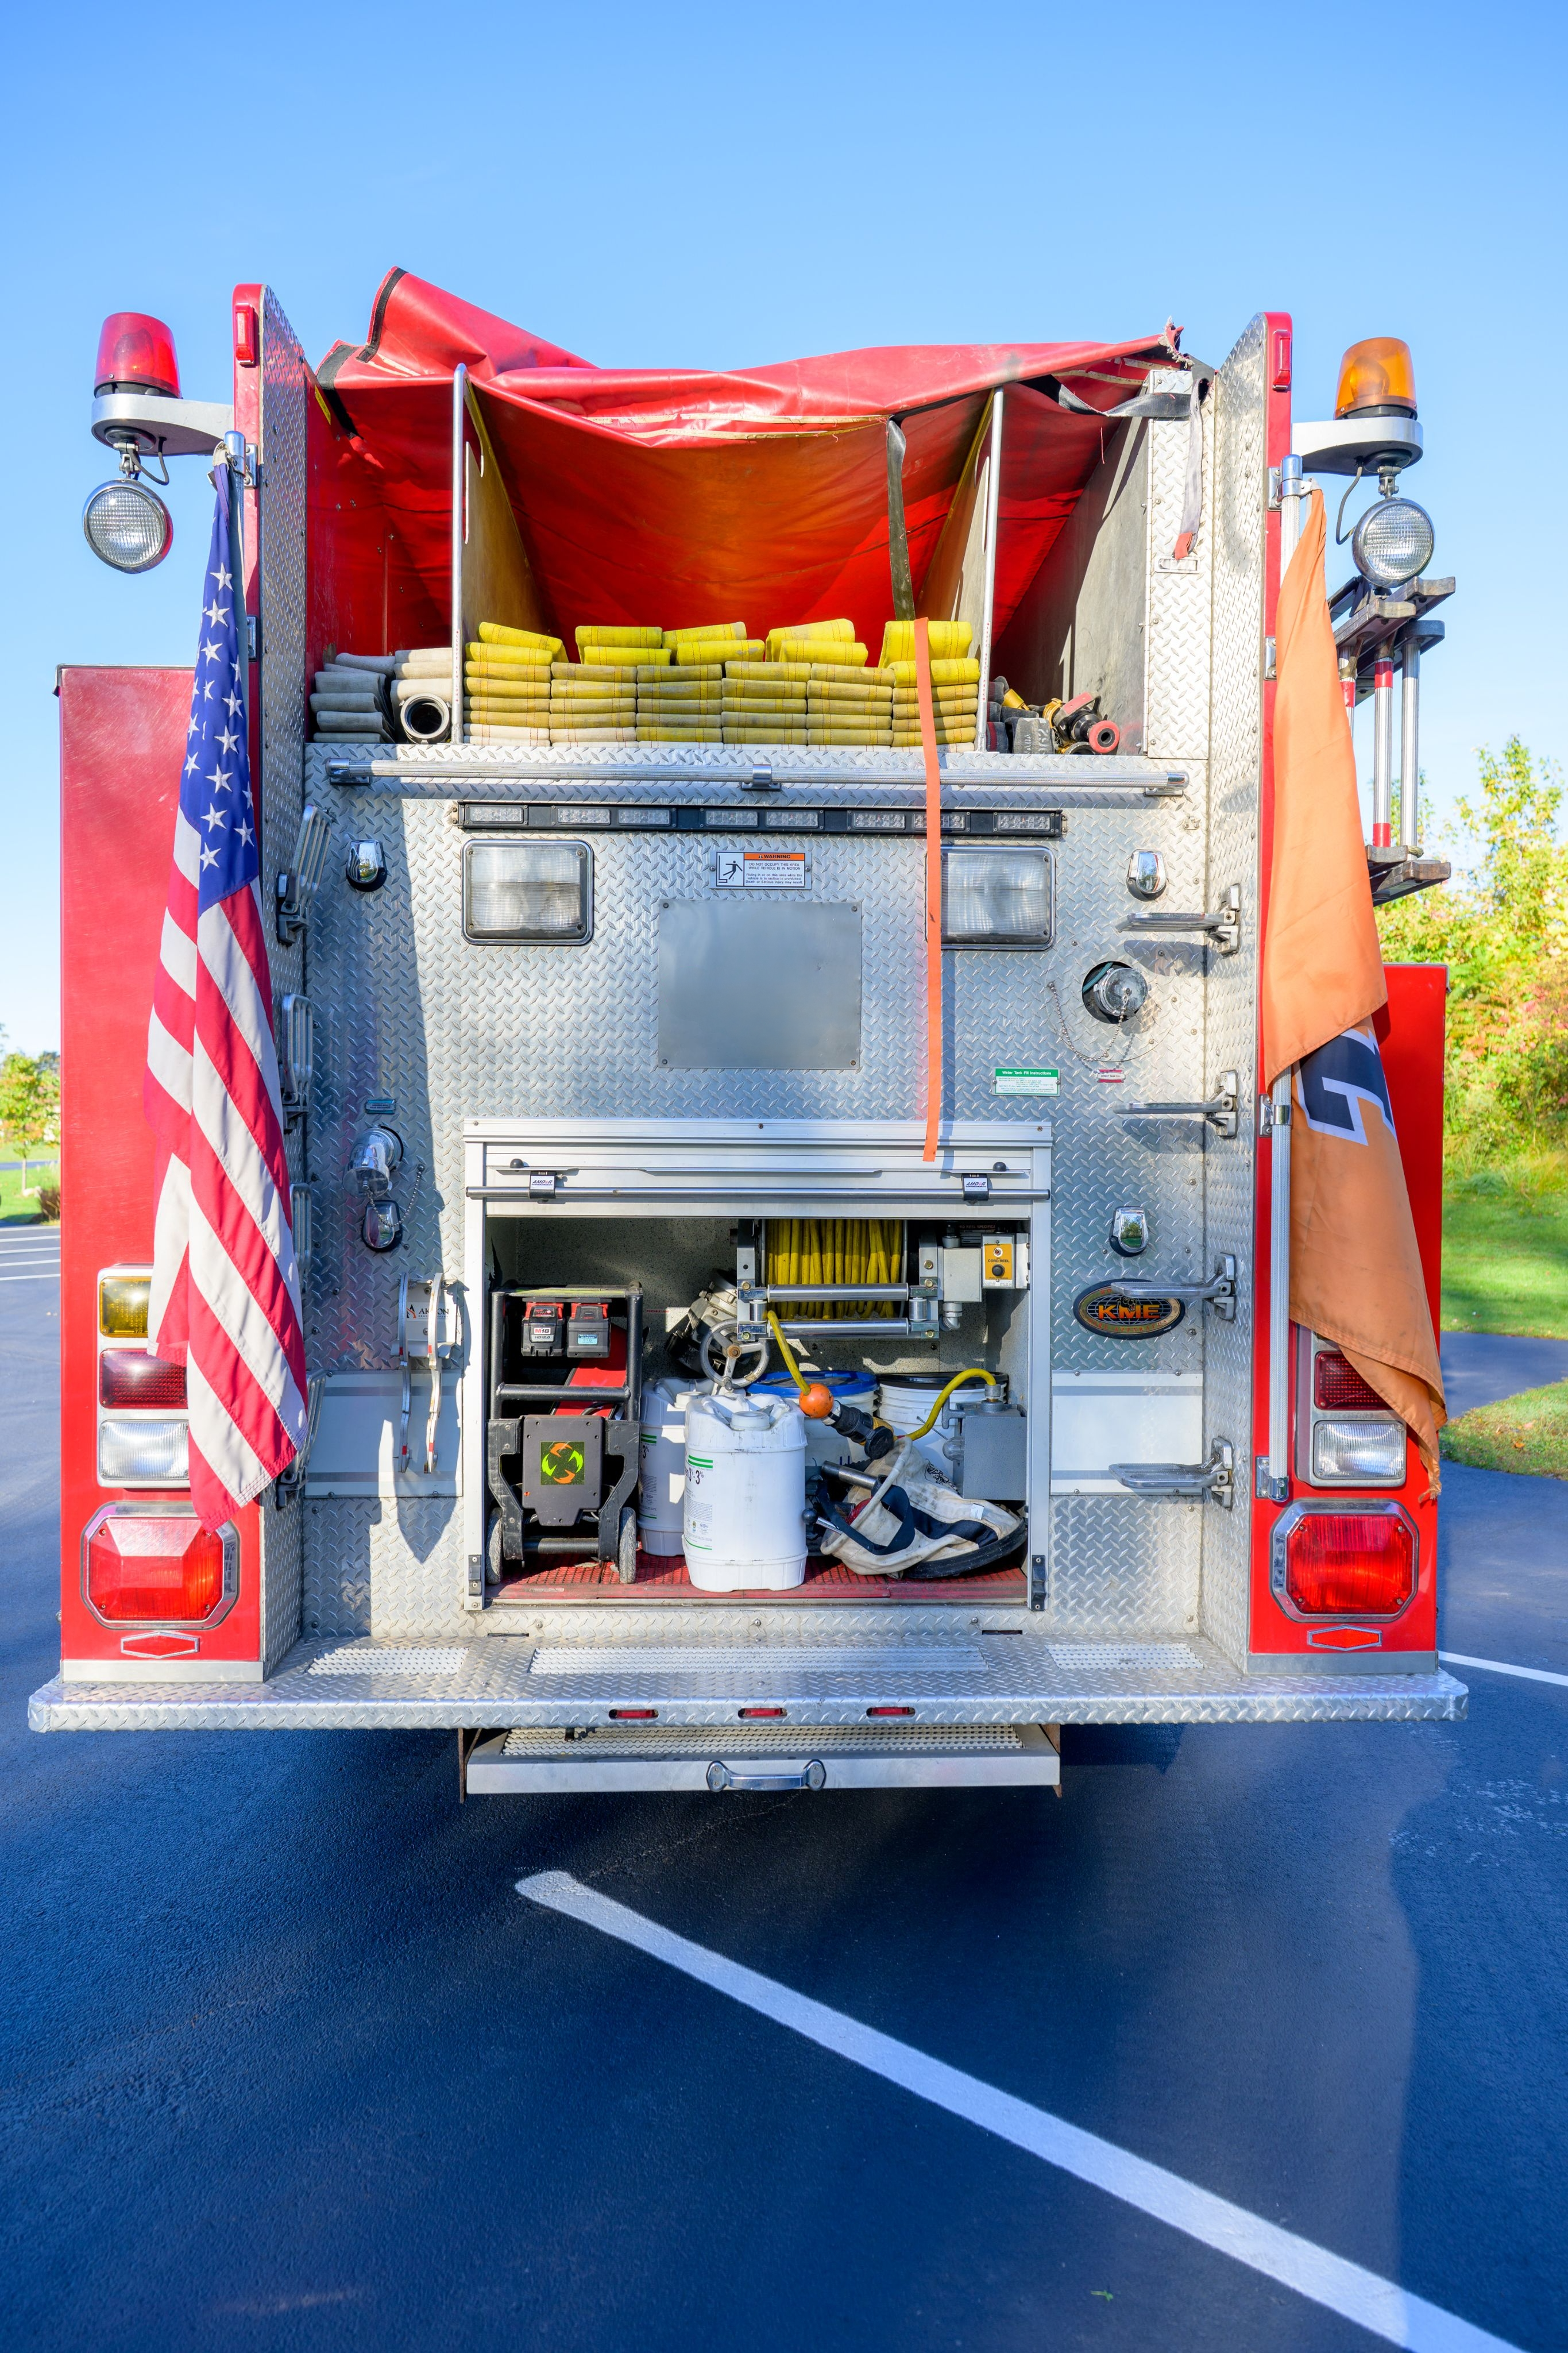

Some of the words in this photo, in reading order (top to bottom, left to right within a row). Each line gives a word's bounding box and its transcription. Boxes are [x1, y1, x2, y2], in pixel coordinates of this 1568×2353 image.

[1098, 1305, 1160, 1320] KME
[1088, 1318, 1108, 1330] FIRE
[1114, 1319, 1168, 1332] APPARATUS
